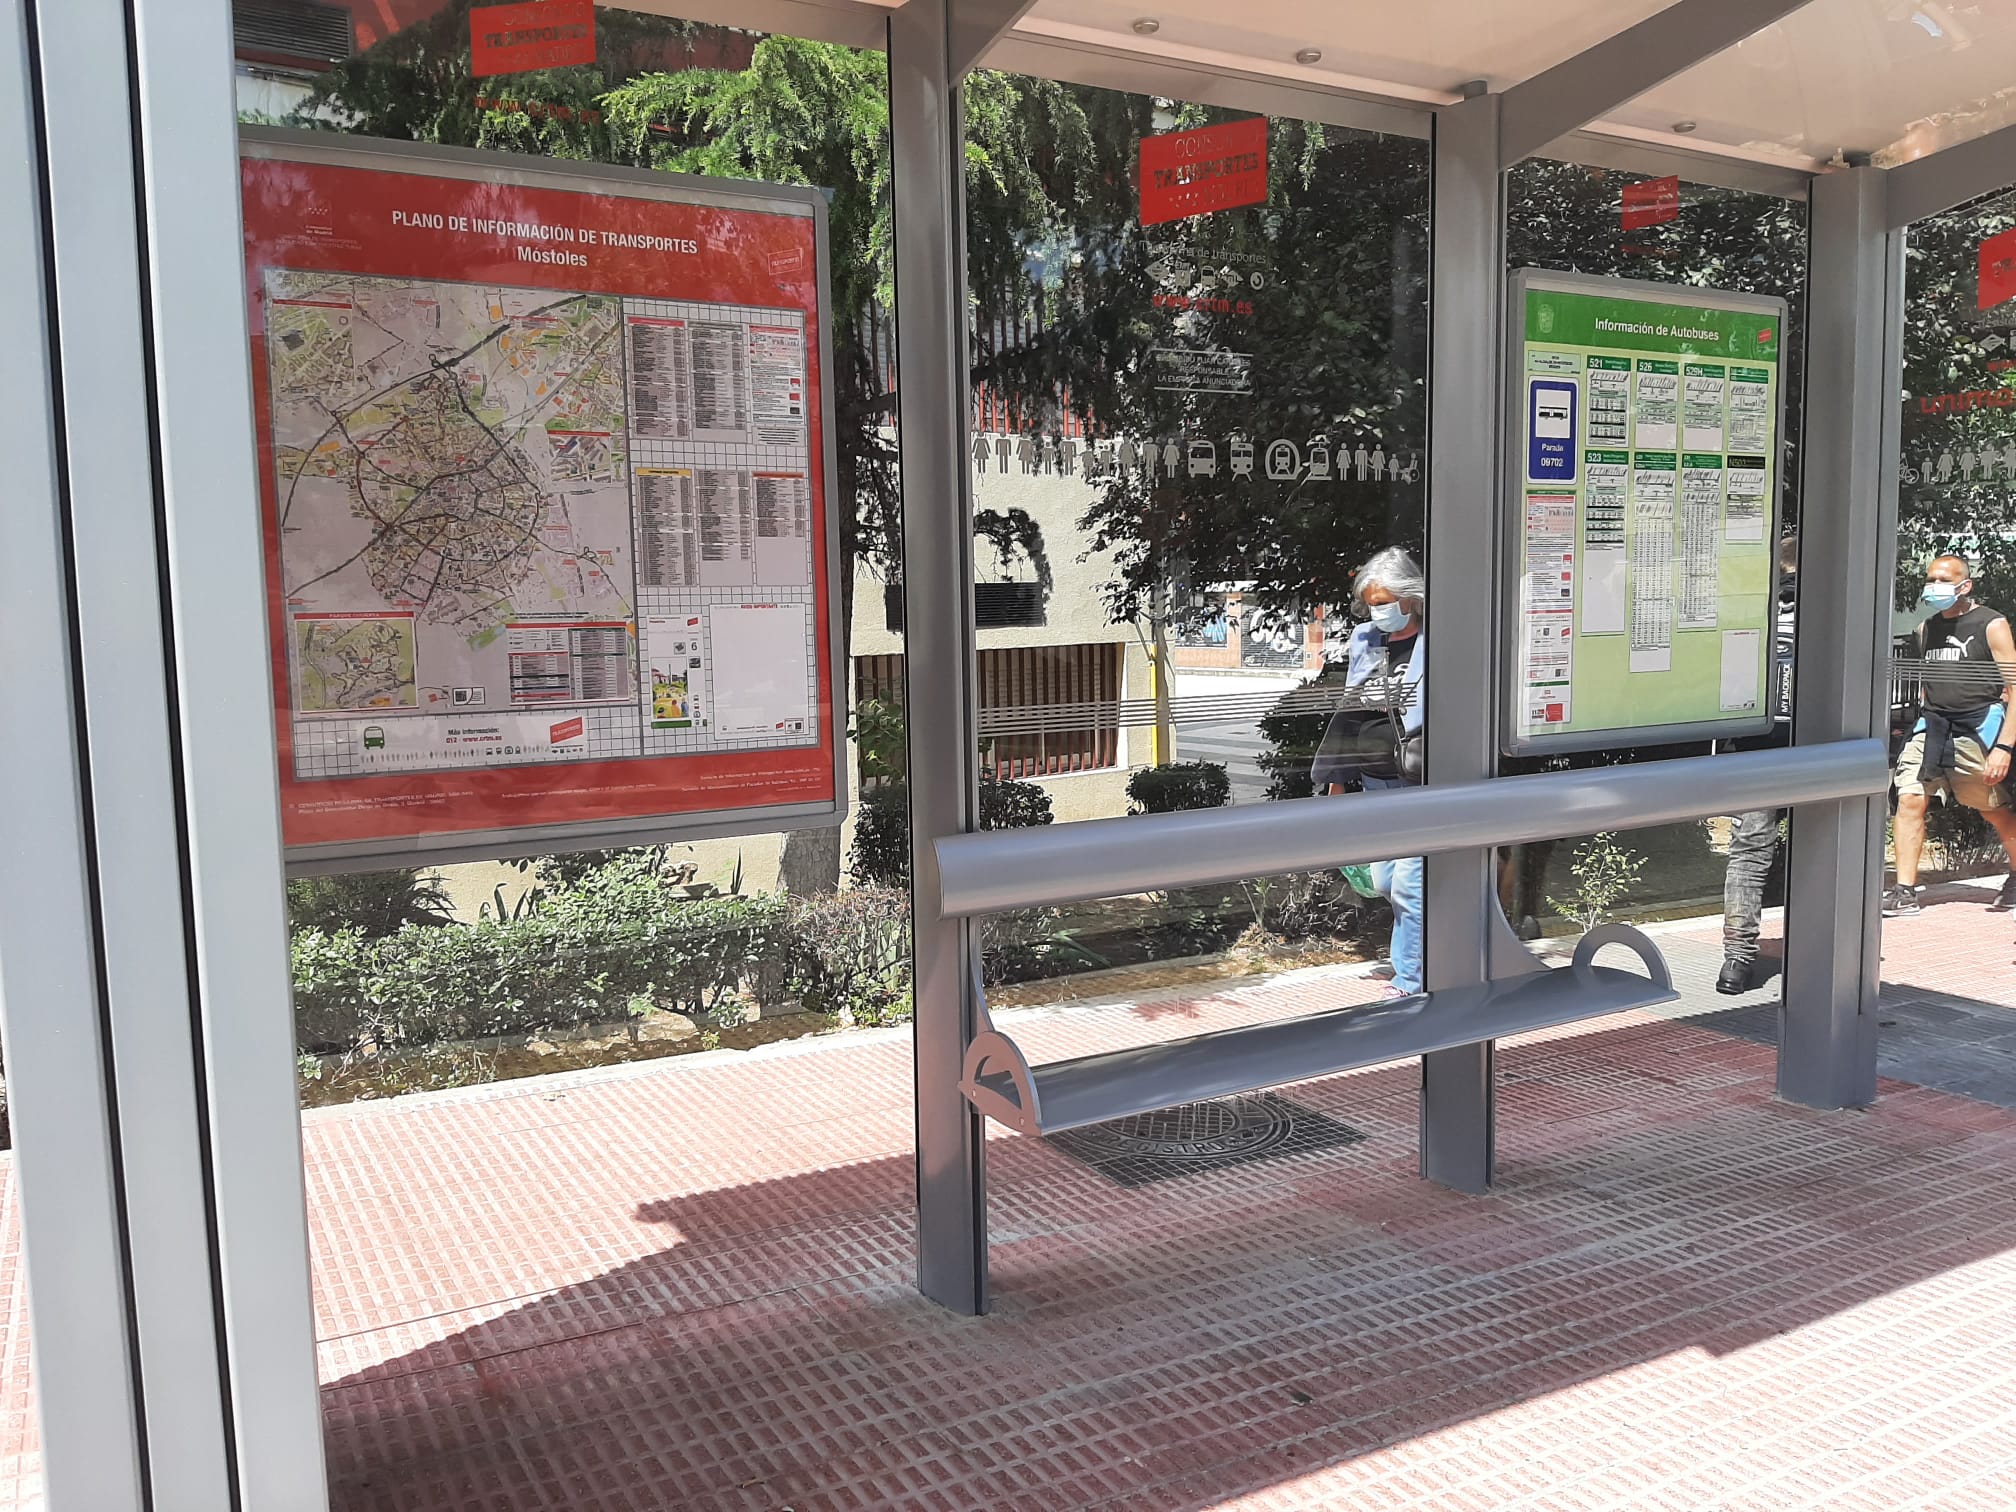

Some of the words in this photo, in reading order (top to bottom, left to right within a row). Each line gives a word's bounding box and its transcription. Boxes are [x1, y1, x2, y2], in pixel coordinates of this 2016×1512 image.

[1155, 152, 1259, 188] TRANSPORTES
[392, 210, 444, 229] PLANO
[448, 215, 468, 231] DE
[472, 218, 575, 242] INFORMACIÓN
[579, 229, 597, 244] DE
[600, 231, 698, 254] TRANSPORTES
[517, 246, 588, 267] Móstoles
[1595, 317, 1654, 335] Información
[1656, 324, 1669, 336] de
[1670, 325, 1719, 341] Autobuses
[1589, 358, 1603, 369] 521
[1639, 362, 1653, 372] 526
[1920, 387, 2016, 413] unimo
[1541, 443, 1563, 452] Parada
[1541, 457, 1564, 467] 09702
[1587, 452, 1602, 463] 523
[1781, 701, 1789, 713] MY
